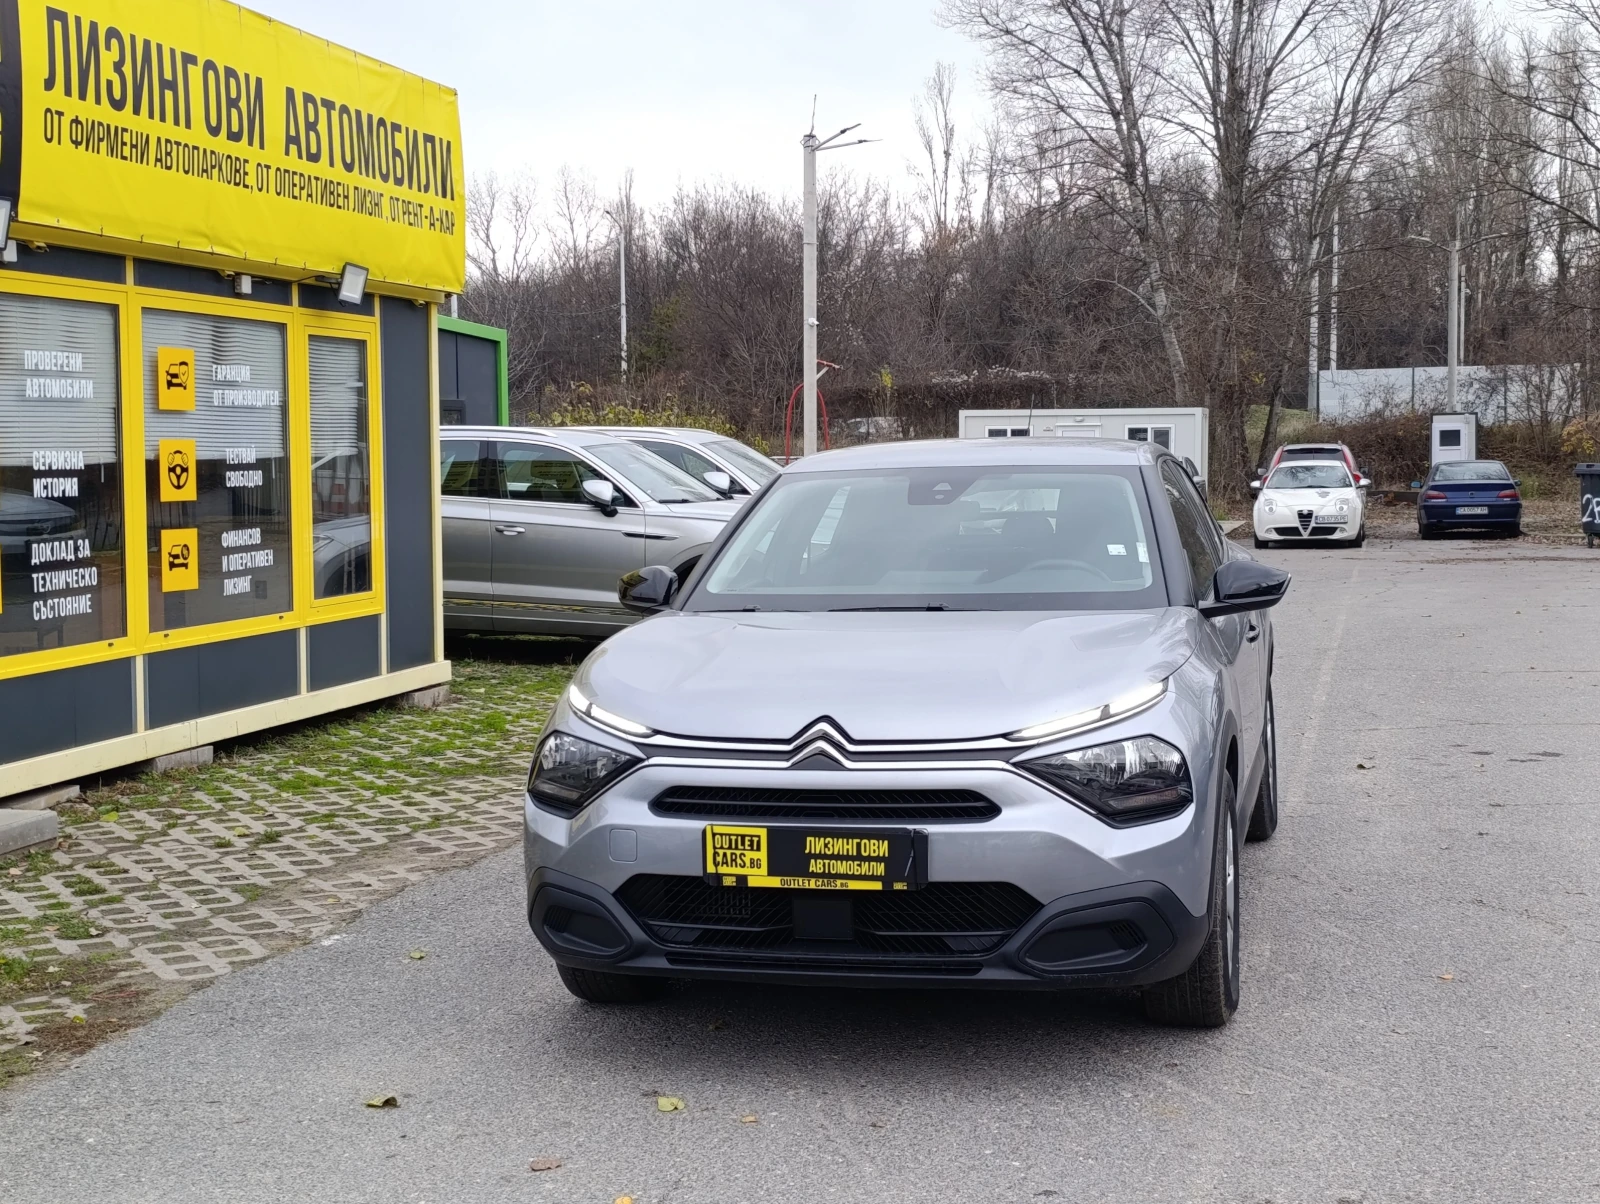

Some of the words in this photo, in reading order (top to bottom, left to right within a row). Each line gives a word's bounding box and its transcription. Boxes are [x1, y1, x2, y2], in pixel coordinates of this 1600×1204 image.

[44, 5, 265, 151] ЛИЗИНГОВИ
[284, 86, 455, 202] АВТОМОБИЛИ
[43, 107, 65, 146] ОТ
[69, 115, 150, 167] ФИРМЕНИ
[154, 136, 254, 194] АВТОПАРКОВЕ,
[256, 162, 272, 194] ОТ
[274, 166, 350, 212] ОПЕРАТИВЕН
[389, 195, 401, 223] ОТ
[24, 350, 83, 372] ПРОВЕРЕНИ
[212, 364, 251, 383] ГАРАНЦИЯ
[25, 378, 94, 399] АВТОМОБИЛИ
[32, 450, 85, 472] СЕРВИЗНА
[225, 445, 257, 465] ТЕСТВАЙ
[33, 477, 79, 498] ИСТОРИЯ
[225, 469, 264, 488] СВОБОДНО
[221, 527, 262, 548] ФИНАНСОВ
[31, 539, 76, 566] ДОКЛАД
[77, 538, 91, 559] ЗА
[222, 554, 228, 573] И
[228, 549, 274, 571] ОПЕРАТИВЕН
[31, 566, 98, 593] ТЕХНИЧЕСКО
[223, 575, 252, 597] ЛИЗИНГ
[32, 594, 93, 621] СЪСТОЯНИЕ
[714, 834, 760, 850] OUTLET
[805, 836, 889, 858] ЛИЗИНГОВИ
[712, 851, 762, 869] CARS.BG
[809, 859, 885, 876] АВТОМОБИЛИ
[780, 877, 812, 888] OUTLET
